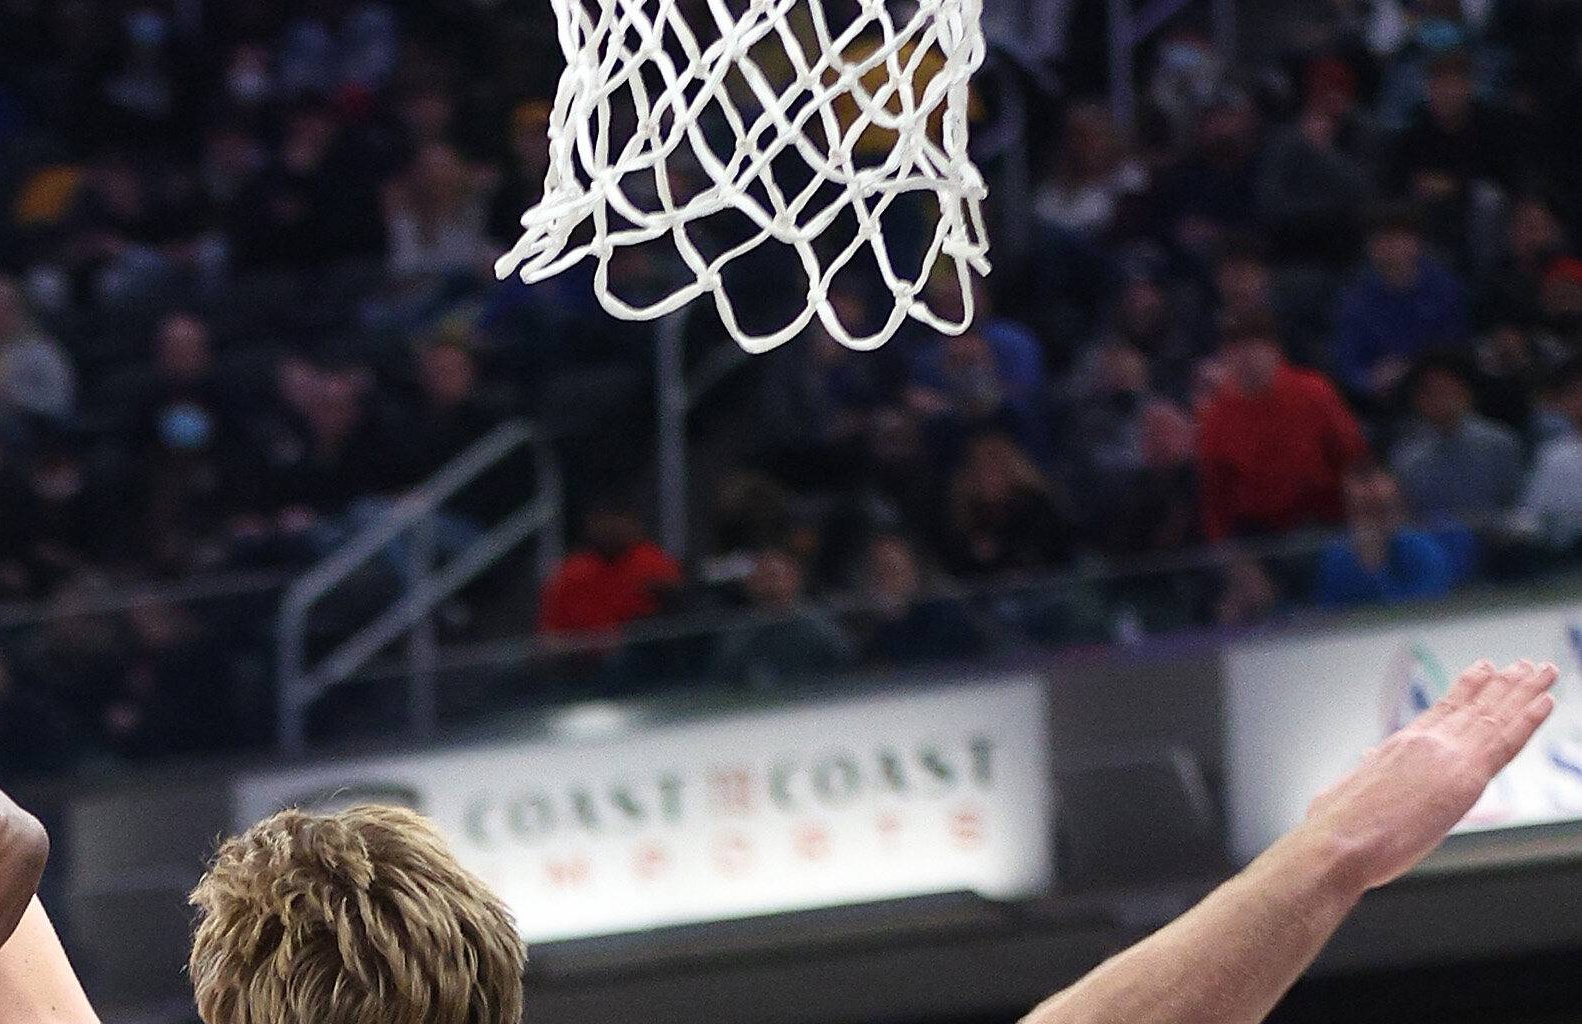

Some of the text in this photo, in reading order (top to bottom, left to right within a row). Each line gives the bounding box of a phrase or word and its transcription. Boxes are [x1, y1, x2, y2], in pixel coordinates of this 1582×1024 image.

[462, 768, 686, 852] COAST
[768, 735, 1000, 812] COAST
[490, 808, 982, 888] MPORTS
